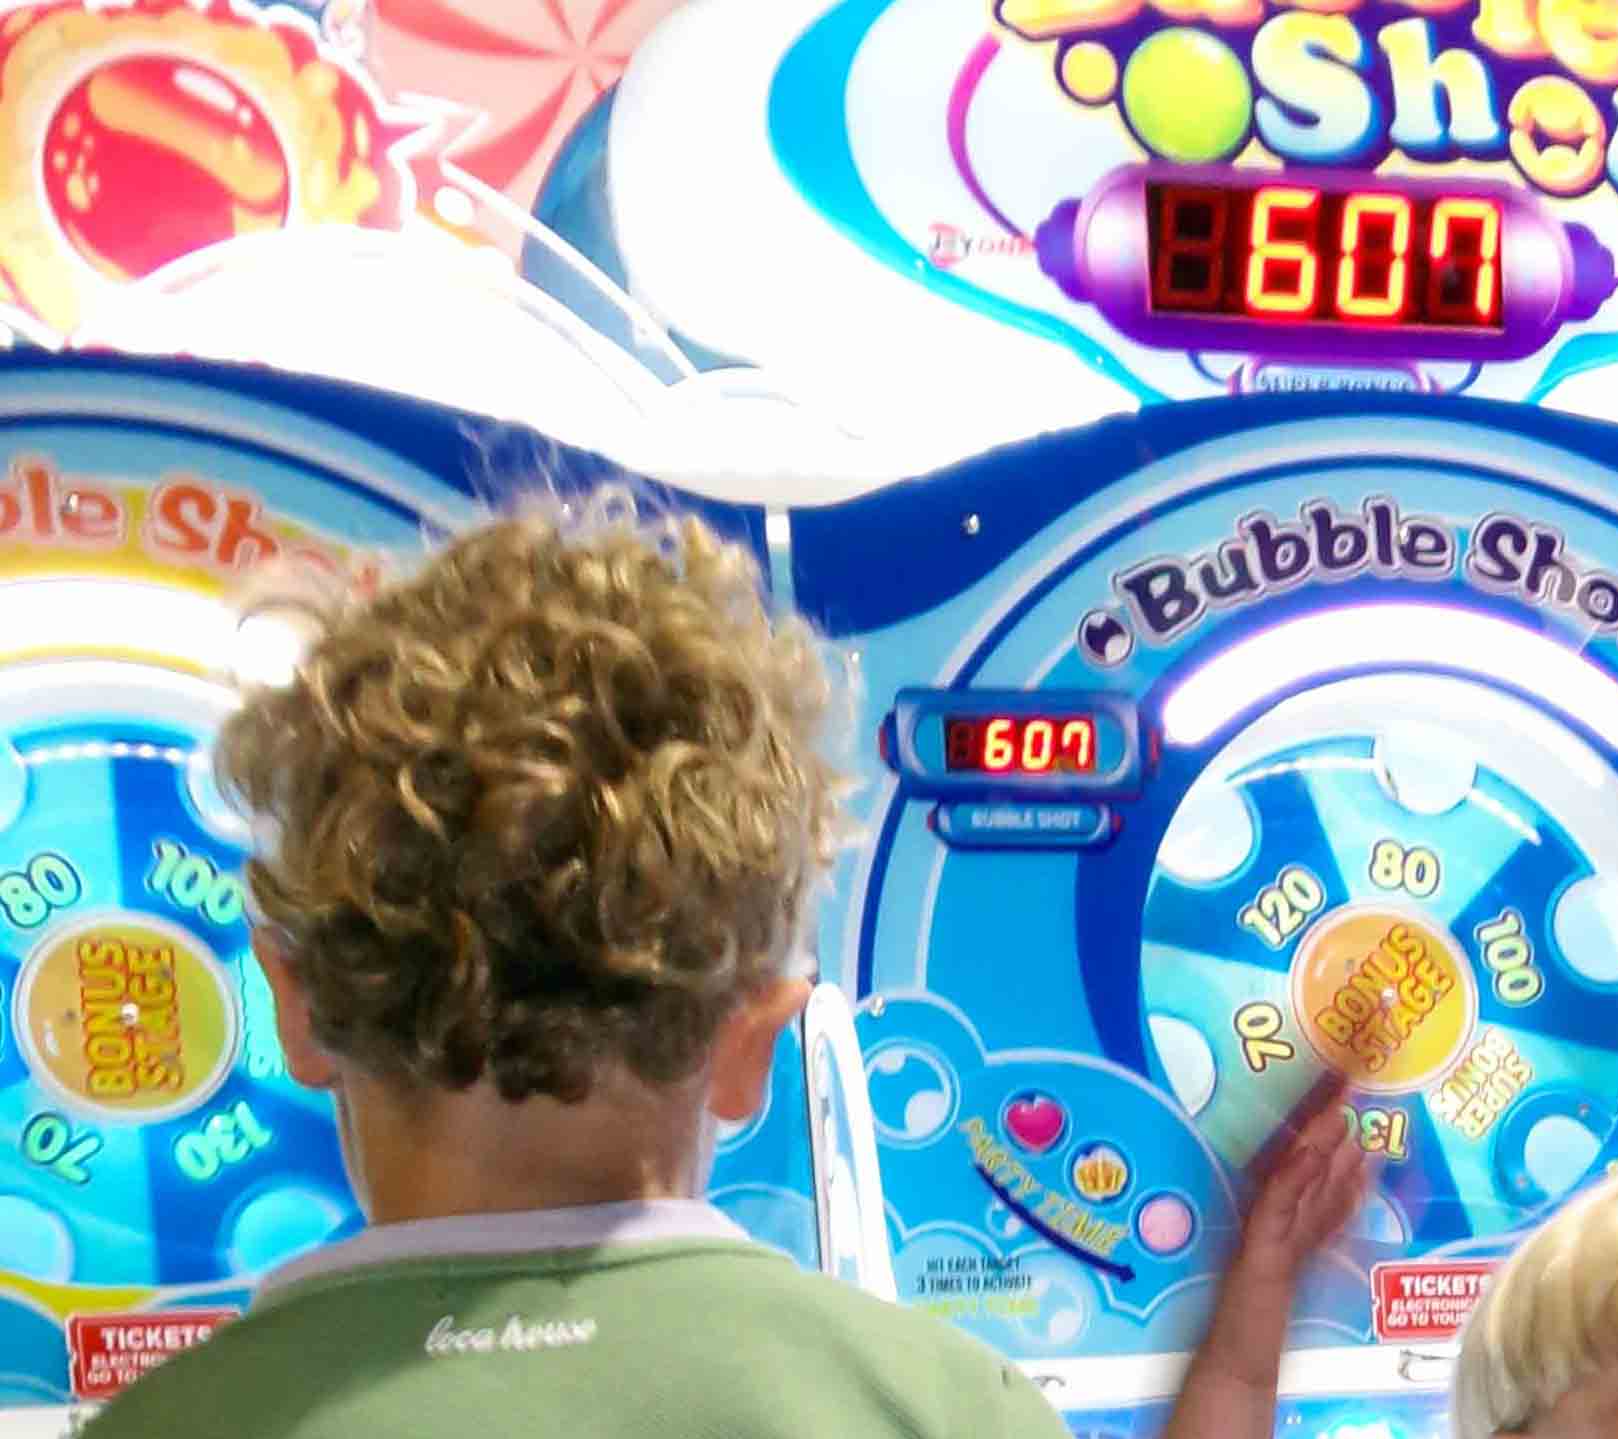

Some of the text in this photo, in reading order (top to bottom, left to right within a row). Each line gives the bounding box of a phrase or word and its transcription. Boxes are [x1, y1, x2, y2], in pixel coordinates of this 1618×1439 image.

[1246, 187, 1501, 319] 607
[1113, 500, 1450, 636] Bubble
[983, 718, 1092, 770] 607
[1038, 810, 1083, 829] SHOT
[0, 853, 82, 929] 80
[145, 838, 247, 926] 100
[1236, 865, 1325, 949] 120
[1368, 839, 1441, 898] 80
[1314, 921, 1427, 1045] BONUS
[1474, 908, 1543, 1005] 100
[78, 937, 138, 1098] BONUS
[128, 945, 185, 1096] STAGE
[1233, 1000, 1296, 1073] 70
[1350, 958, 1456, 1073] STAGE
[22, 1110, 105, 1186] 70
[173, 1098, 274, 1183] 130
[1344, 1103, 1408, 1162] 13
[1386, 1312, 1409, 1329] GO
[1411, 1312, 1430, 1328] TO
